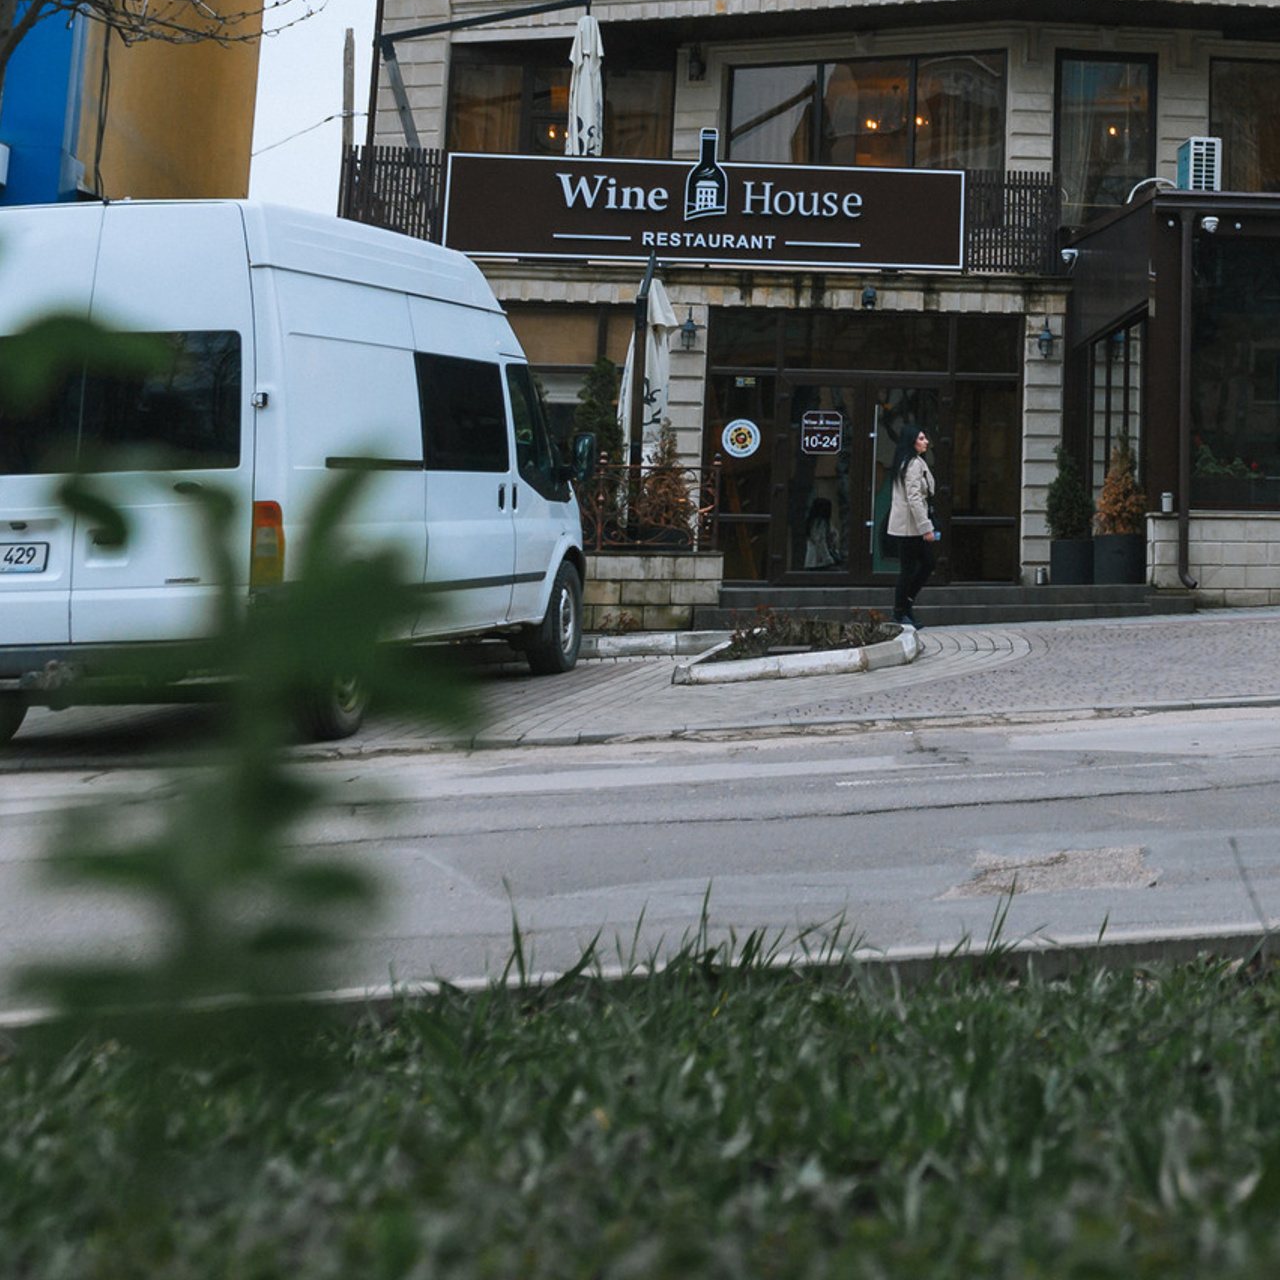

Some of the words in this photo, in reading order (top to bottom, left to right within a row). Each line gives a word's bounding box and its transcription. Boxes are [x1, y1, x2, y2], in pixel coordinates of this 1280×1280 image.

[555, 172, 669, 211] Wine
[740, 181, 863, 218] House
[642, 231, 776, 250] RESTAURANT
[3, 546, 37, 565] 429
